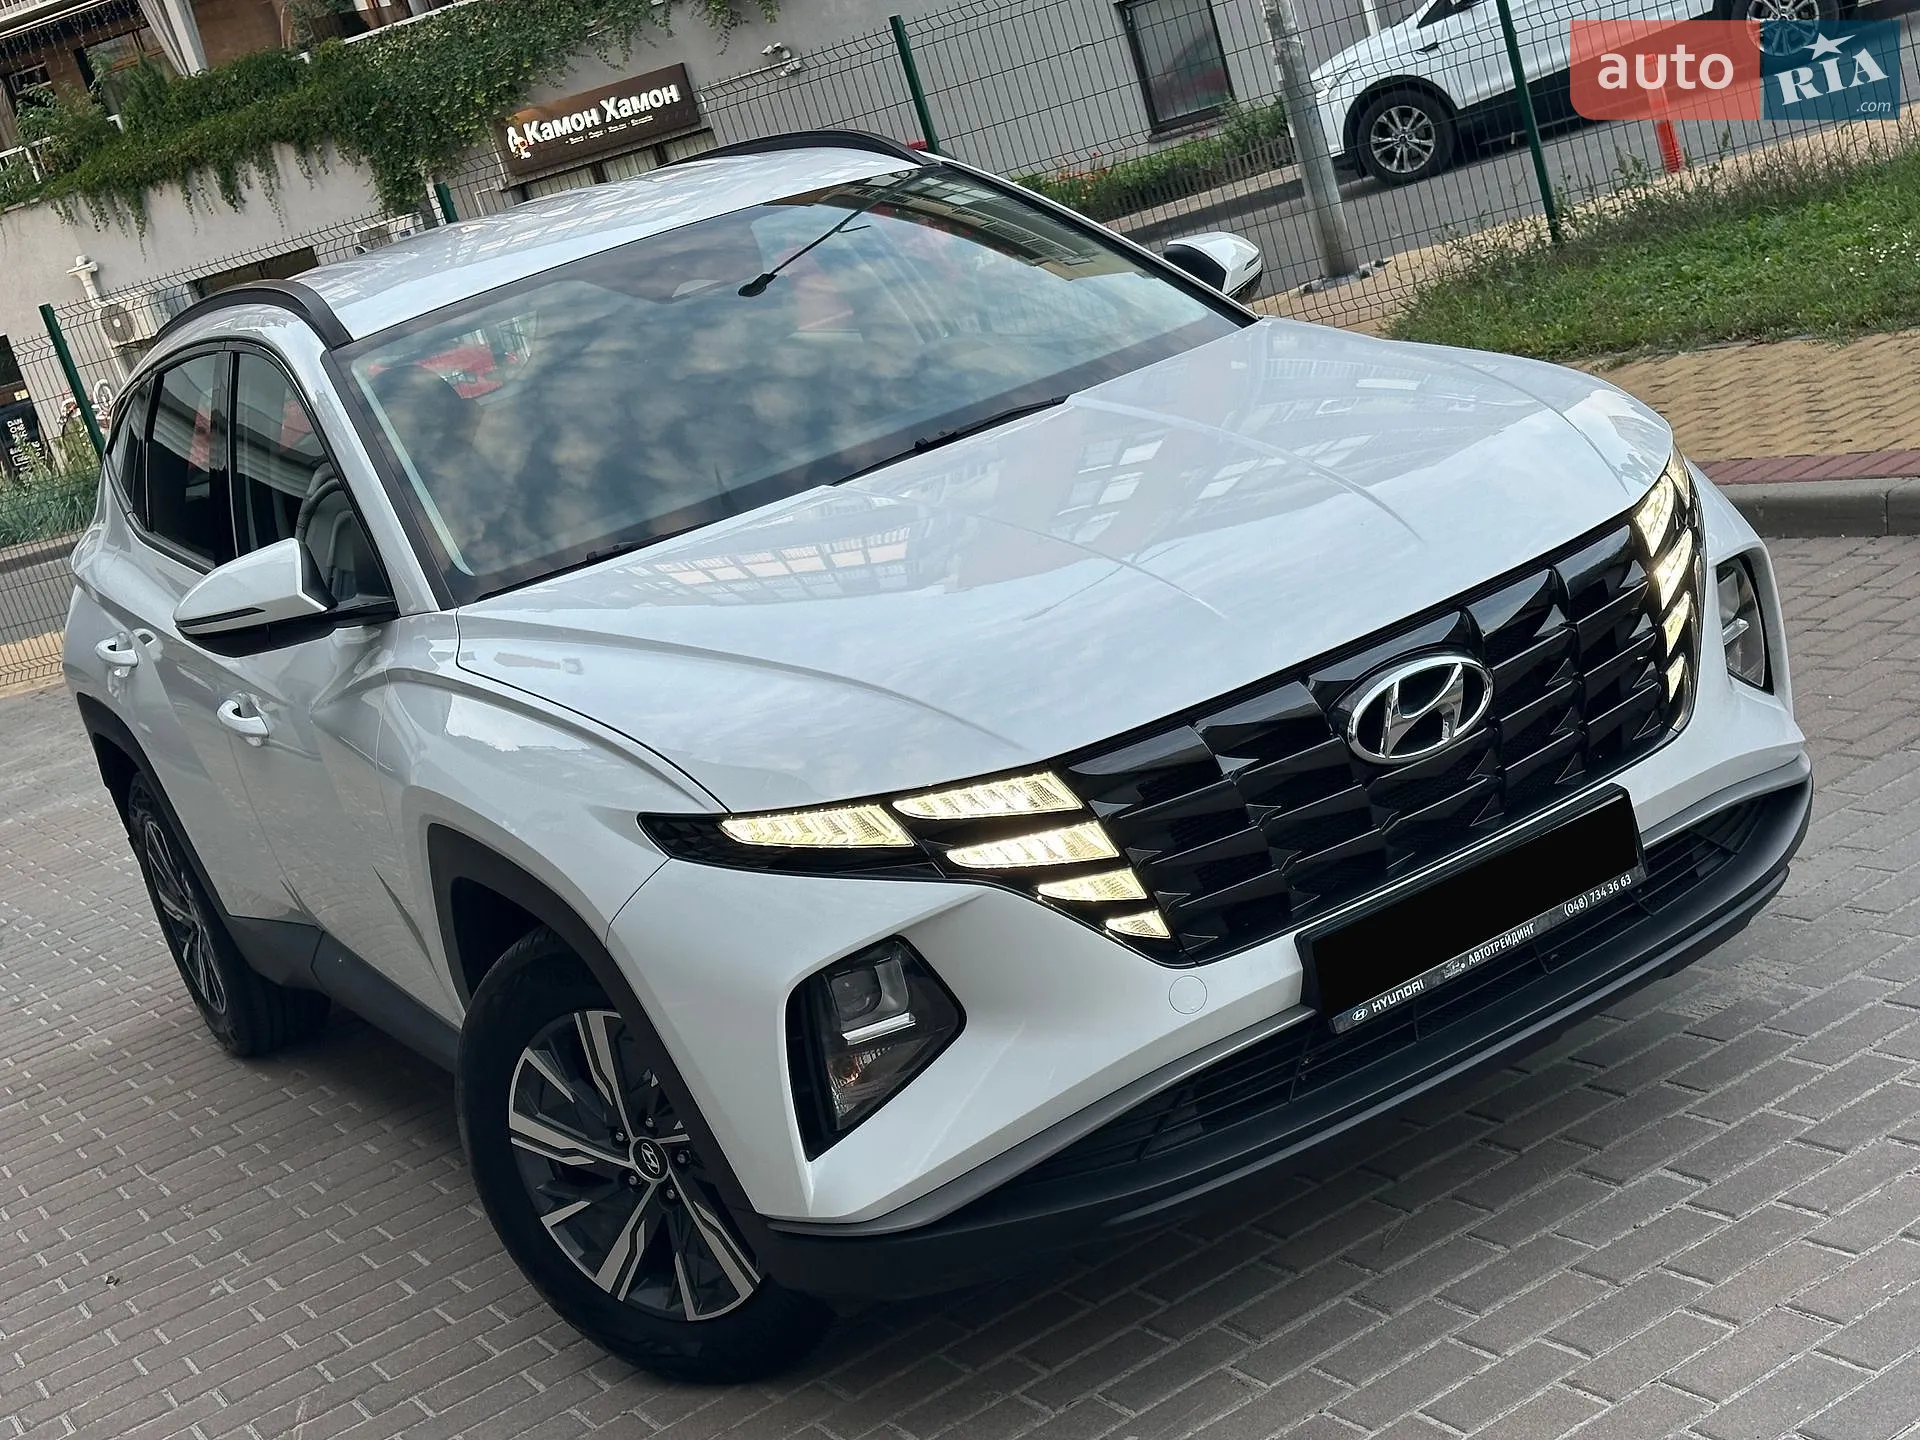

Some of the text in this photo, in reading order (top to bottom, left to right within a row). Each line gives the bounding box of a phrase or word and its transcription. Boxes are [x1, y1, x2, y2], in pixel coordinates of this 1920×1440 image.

[522, 107, 601, 146] Камон
[600, 84, 681, 123] Хамон
[1563, 874, 1632, 917] (048) 734 36 63
[1467, 922, 1535, 966] АВТОТРЕЙДИНГ
[1372, 979, 1425, 1013] HYUNDAI
